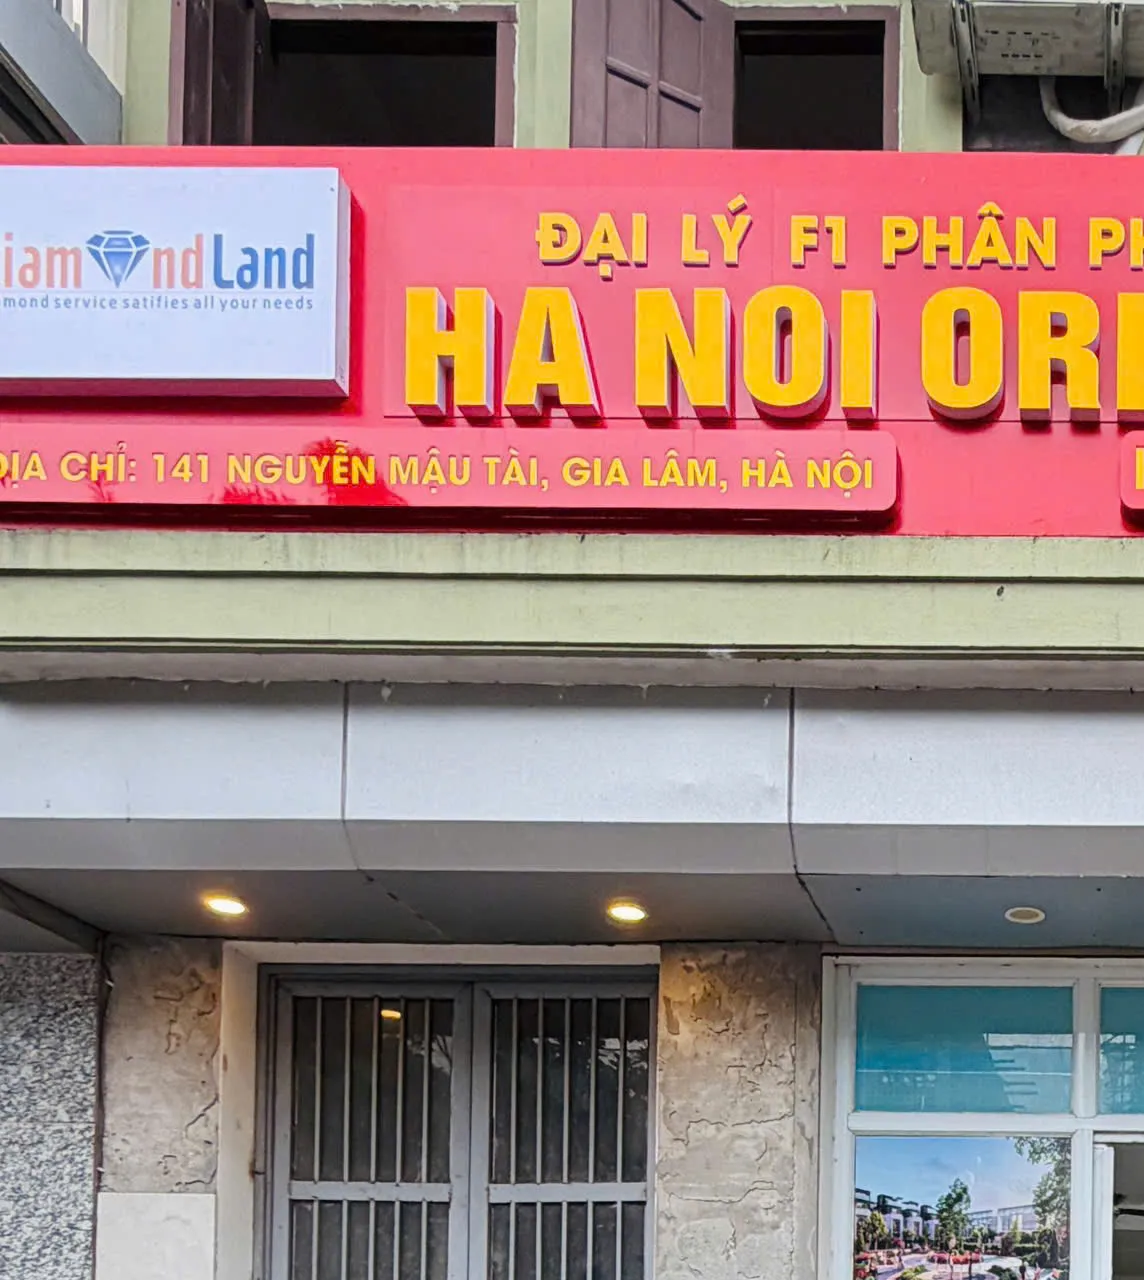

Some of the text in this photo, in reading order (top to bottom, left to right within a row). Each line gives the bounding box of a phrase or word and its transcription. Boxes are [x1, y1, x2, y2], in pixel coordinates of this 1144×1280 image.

[535, 211, 648, 280] ĐẠI
[681, 194, 752, 266] LÝ
[791, 214, 847, 268] F1
[882, 200, 1056, 269] PHÂN
[2, 294, 314, 312] mond service satifies all your needs
[406, 286, 602, 418] HA
[635, 286, 877, 420] NOI
[60, 441, 136, 483] CHỈ:
[152, 452, 208, 484] 141
[227, 441, 376, 487] NGUYỄN
[389, 446, 471, 494] MẬU
[484, 446, 549, 492] TÀI,
[562, 457, 628, 488] GIA
[642, 449, 729, 493] LÂM,
[741, 450, 792, 490] HÀ
[807, 450, 873, 498] NỘI
